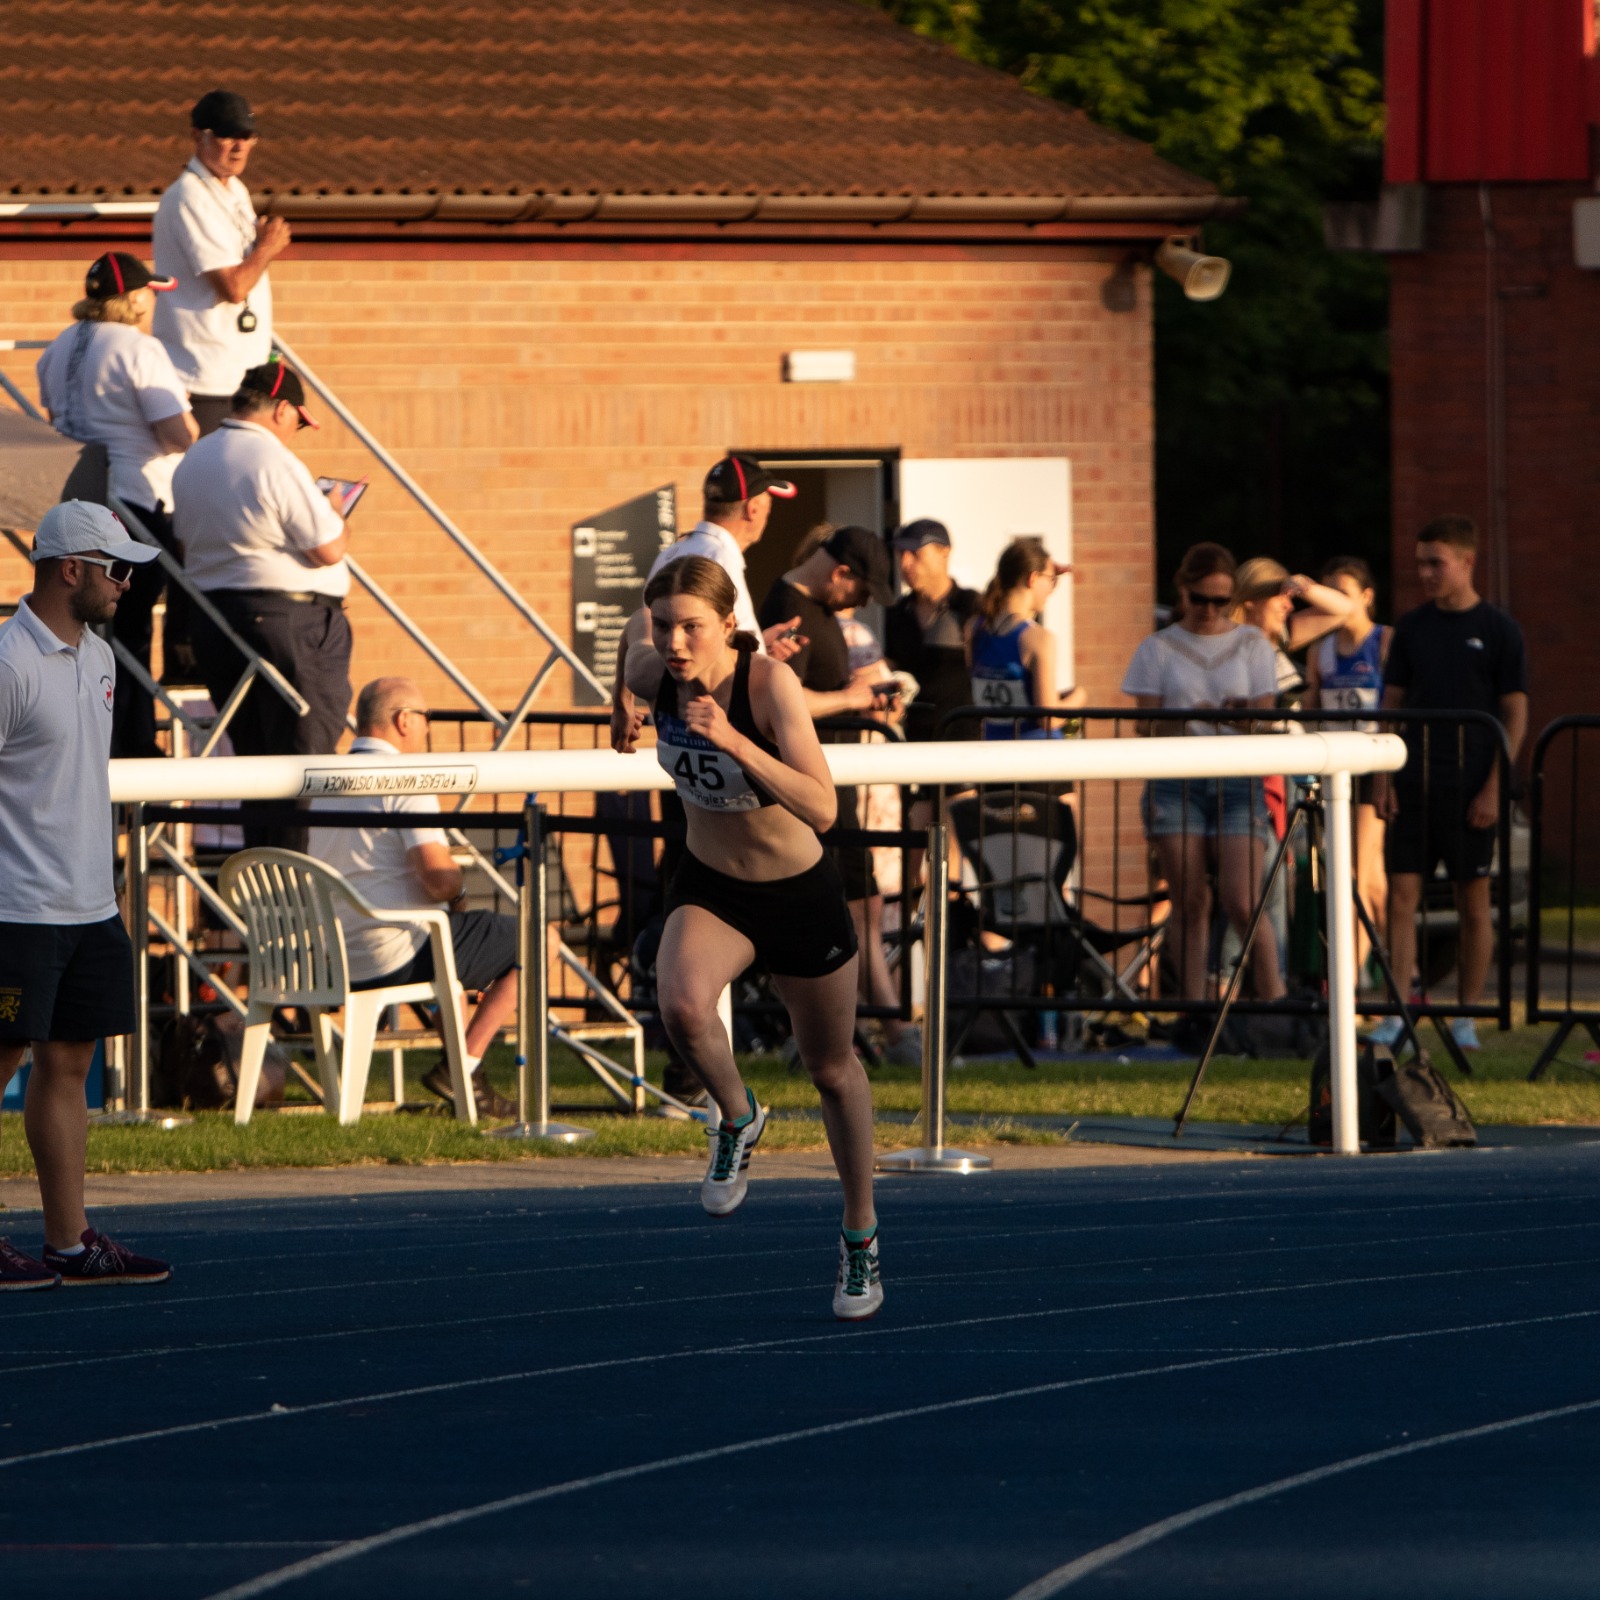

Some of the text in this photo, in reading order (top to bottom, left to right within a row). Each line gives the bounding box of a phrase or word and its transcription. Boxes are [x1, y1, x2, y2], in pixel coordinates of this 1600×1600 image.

[982, 682, 1013, 706] 40
[328, 773, 451, 791] PLEASE MAINTAIN DISTANCE
[674, 751, 725, 790] 45
